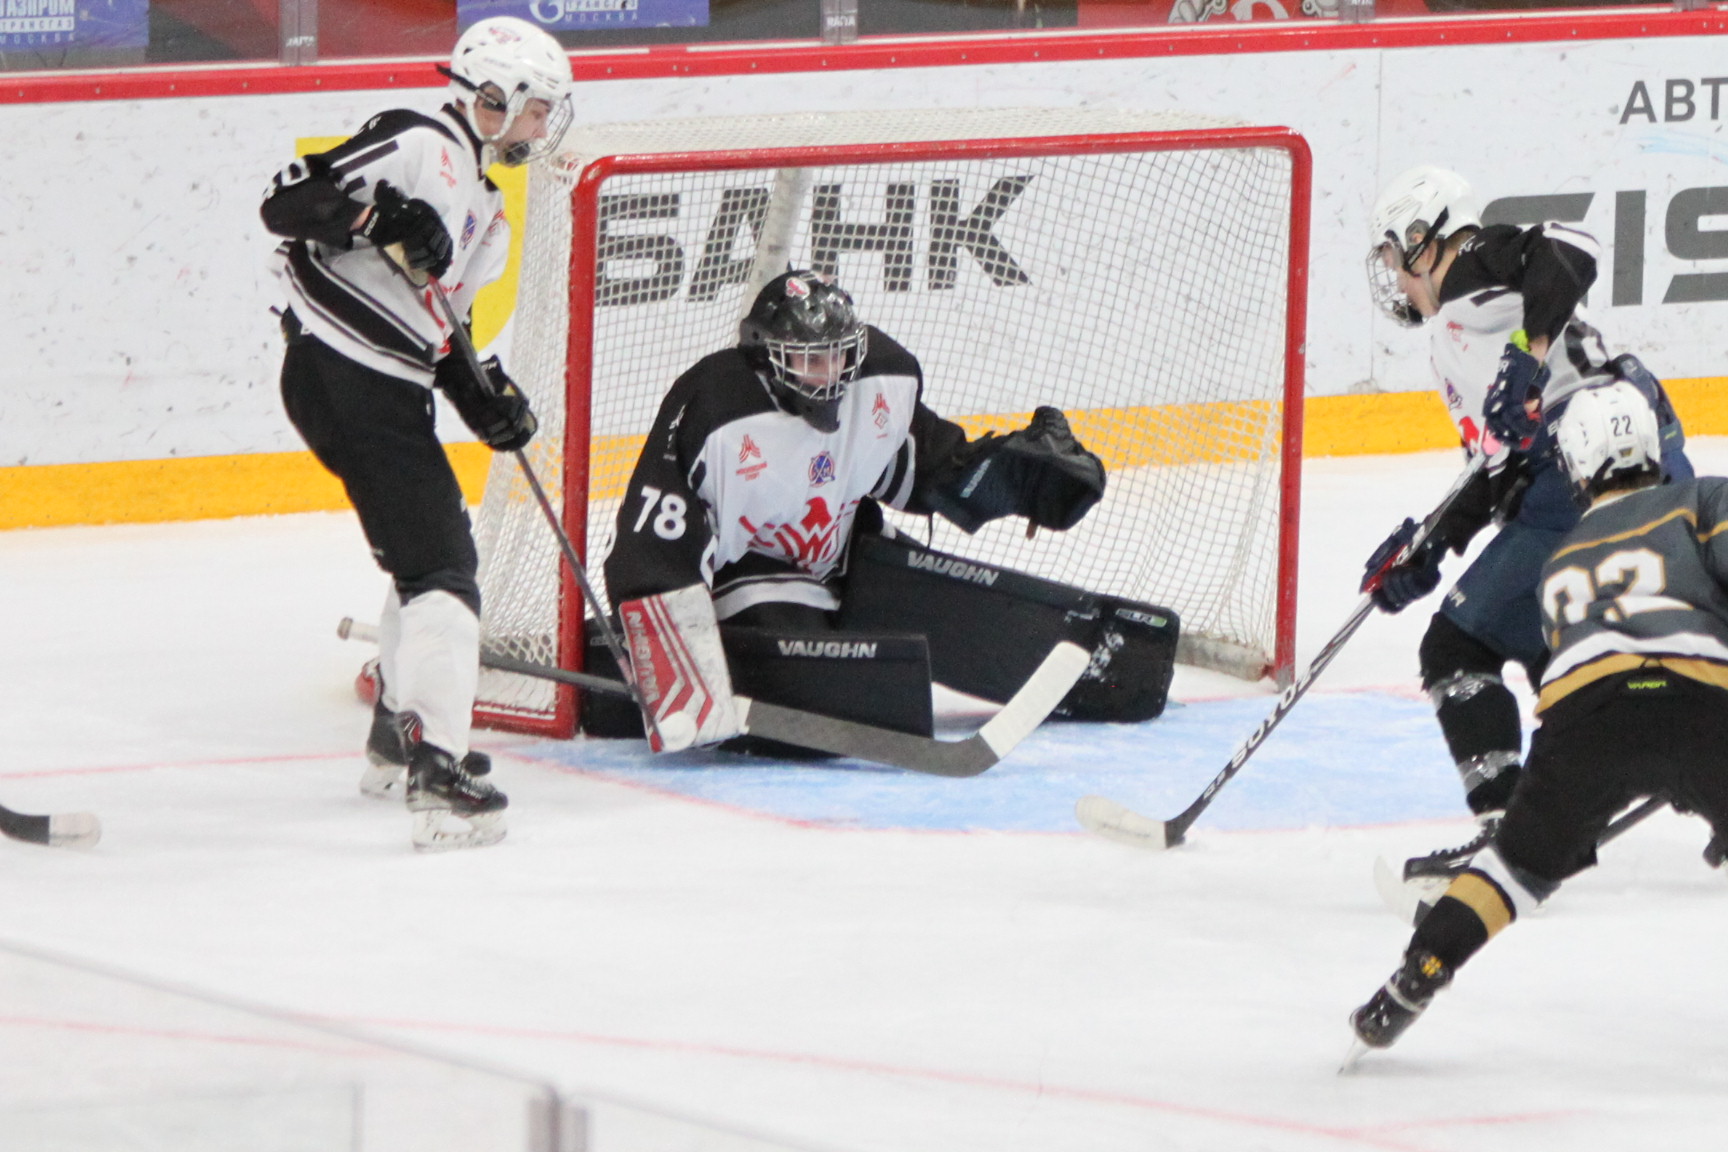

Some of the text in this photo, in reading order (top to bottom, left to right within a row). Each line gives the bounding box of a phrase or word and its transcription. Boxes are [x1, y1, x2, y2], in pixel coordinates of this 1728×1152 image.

[595, 175, 1035, 307] БАНК
[1610, 414, 1634, 438] 22
[632, 485, 687, 541] 78
[907, 550, 1000, 587] VAUGHN
[777, 639, 877, 659] VAUGHN
